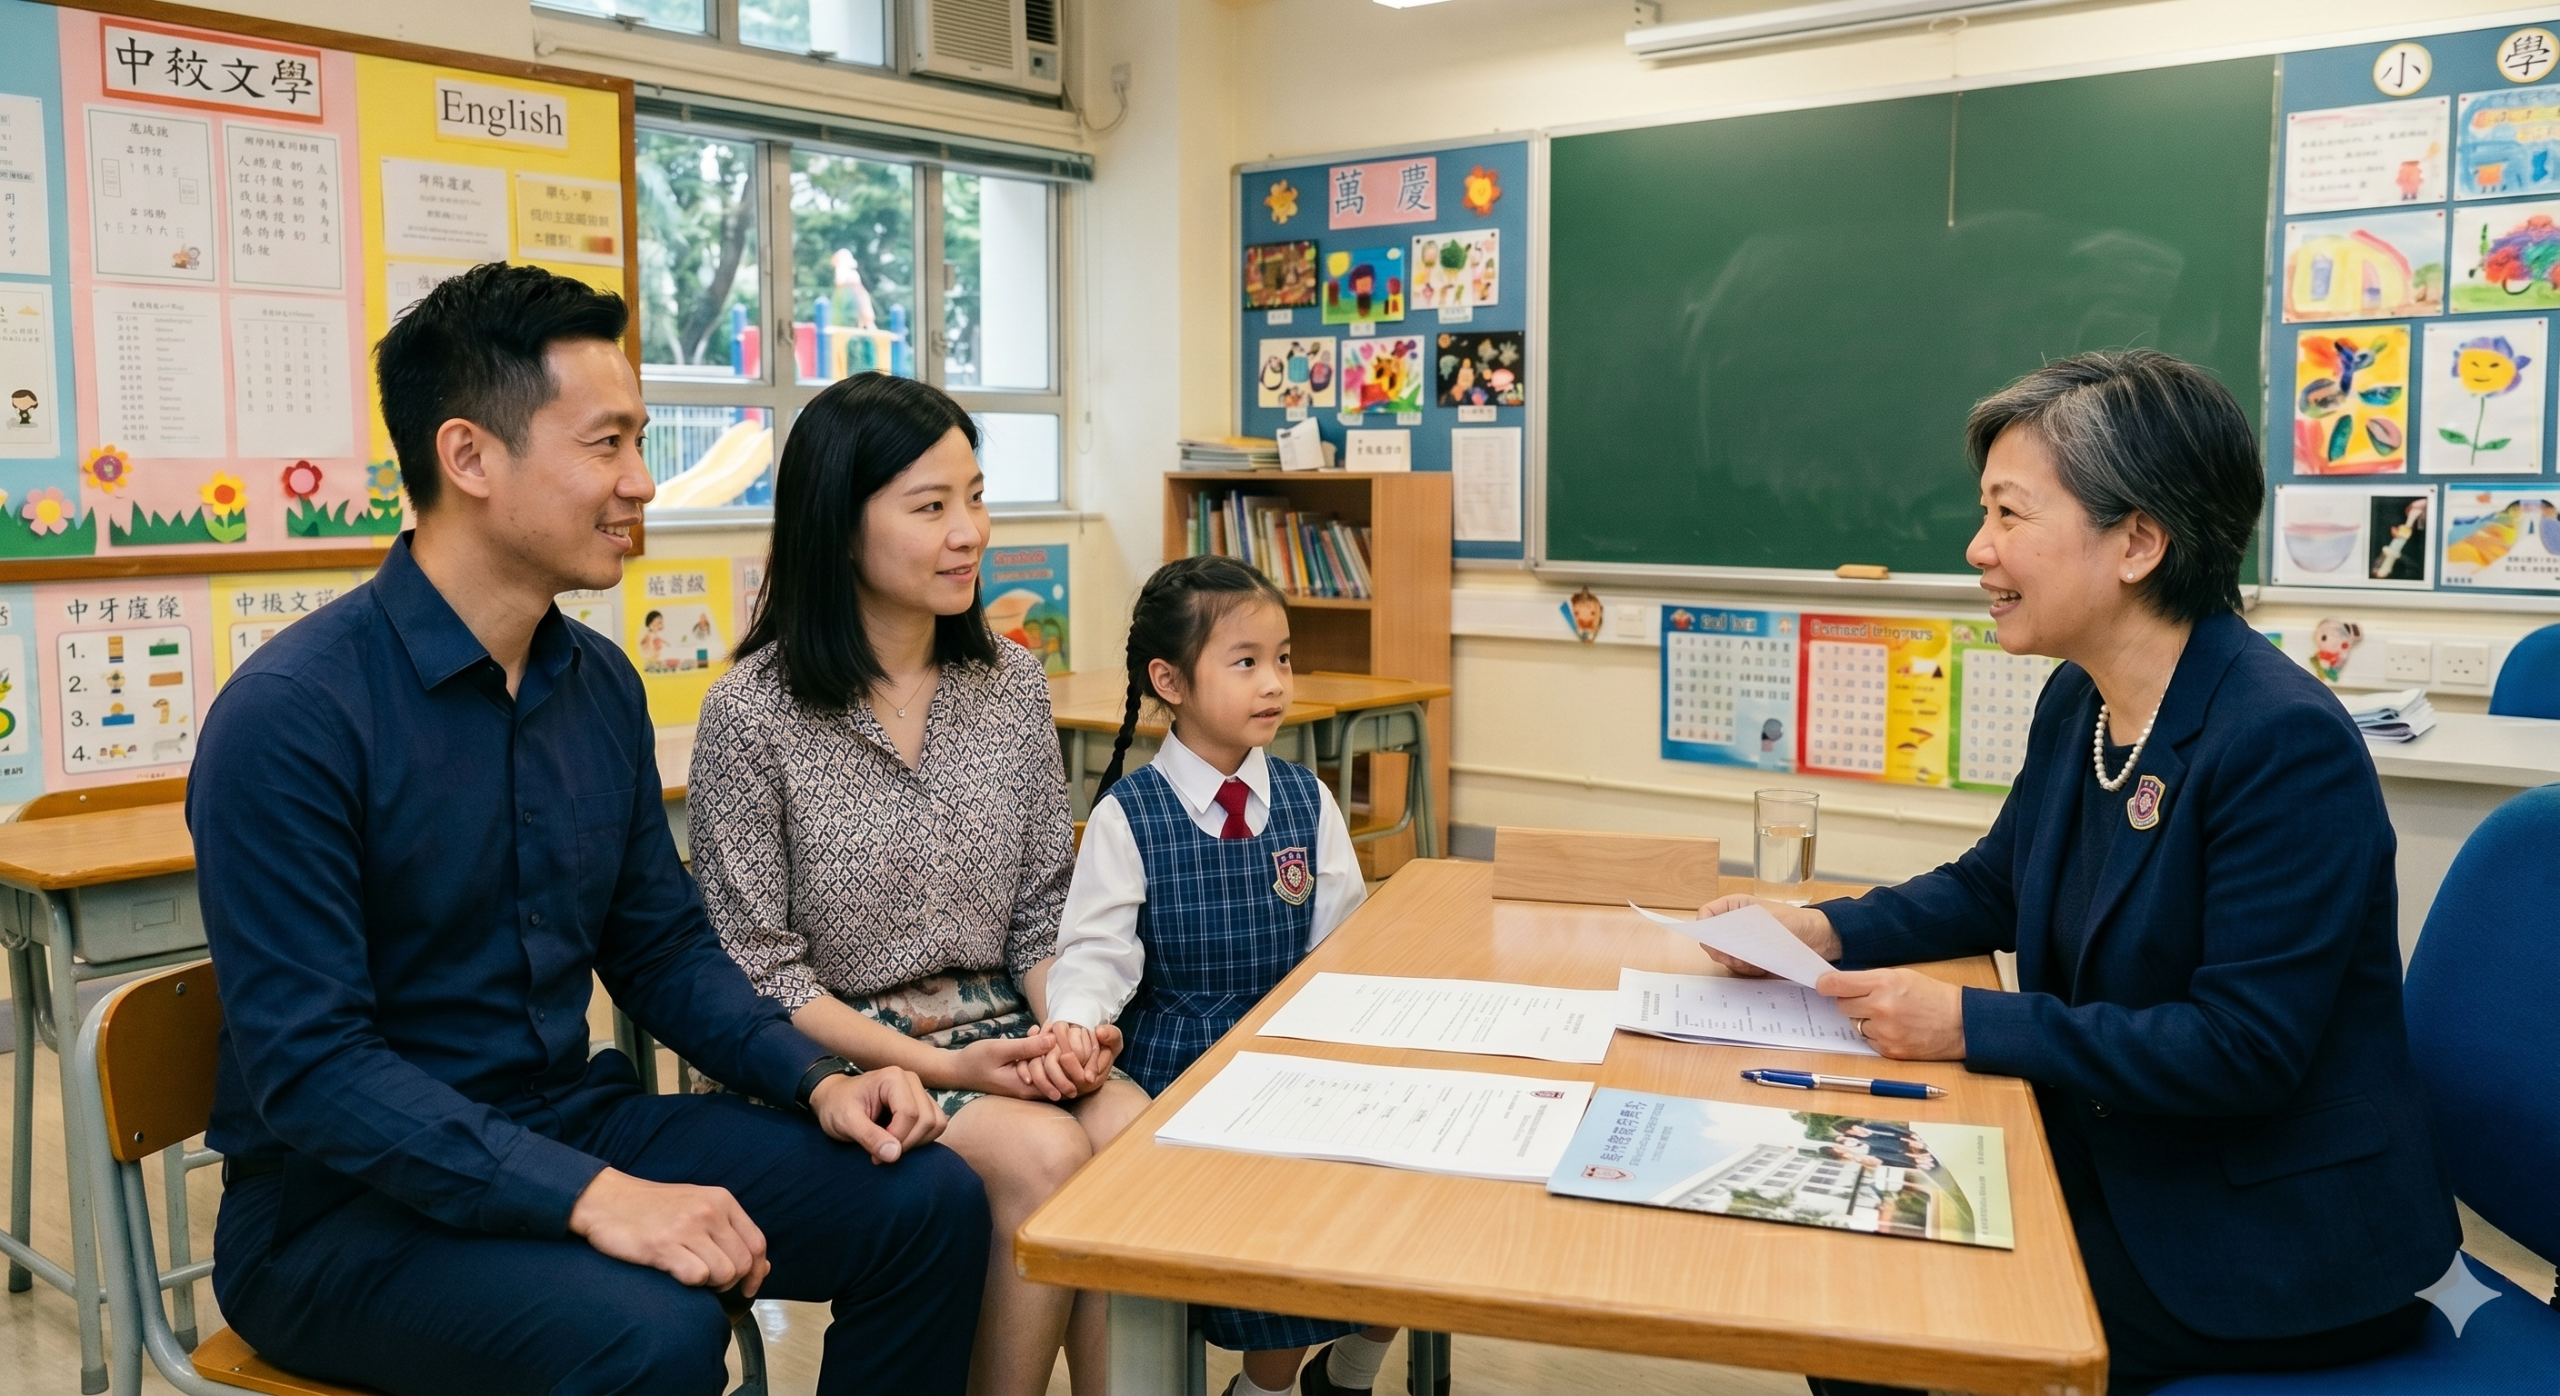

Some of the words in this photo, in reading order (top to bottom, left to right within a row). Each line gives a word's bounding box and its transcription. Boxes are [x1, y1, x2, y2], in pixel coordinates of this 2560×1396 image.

[440, 88, 564, 137] English
[238, 631, 255, 647] 1.
[66, 642, 85, 659] 1.
[69, 676, 88, 693] 2.
[71, 710, 90, 728] 3.
[71, 745, 92, 762] 4.
